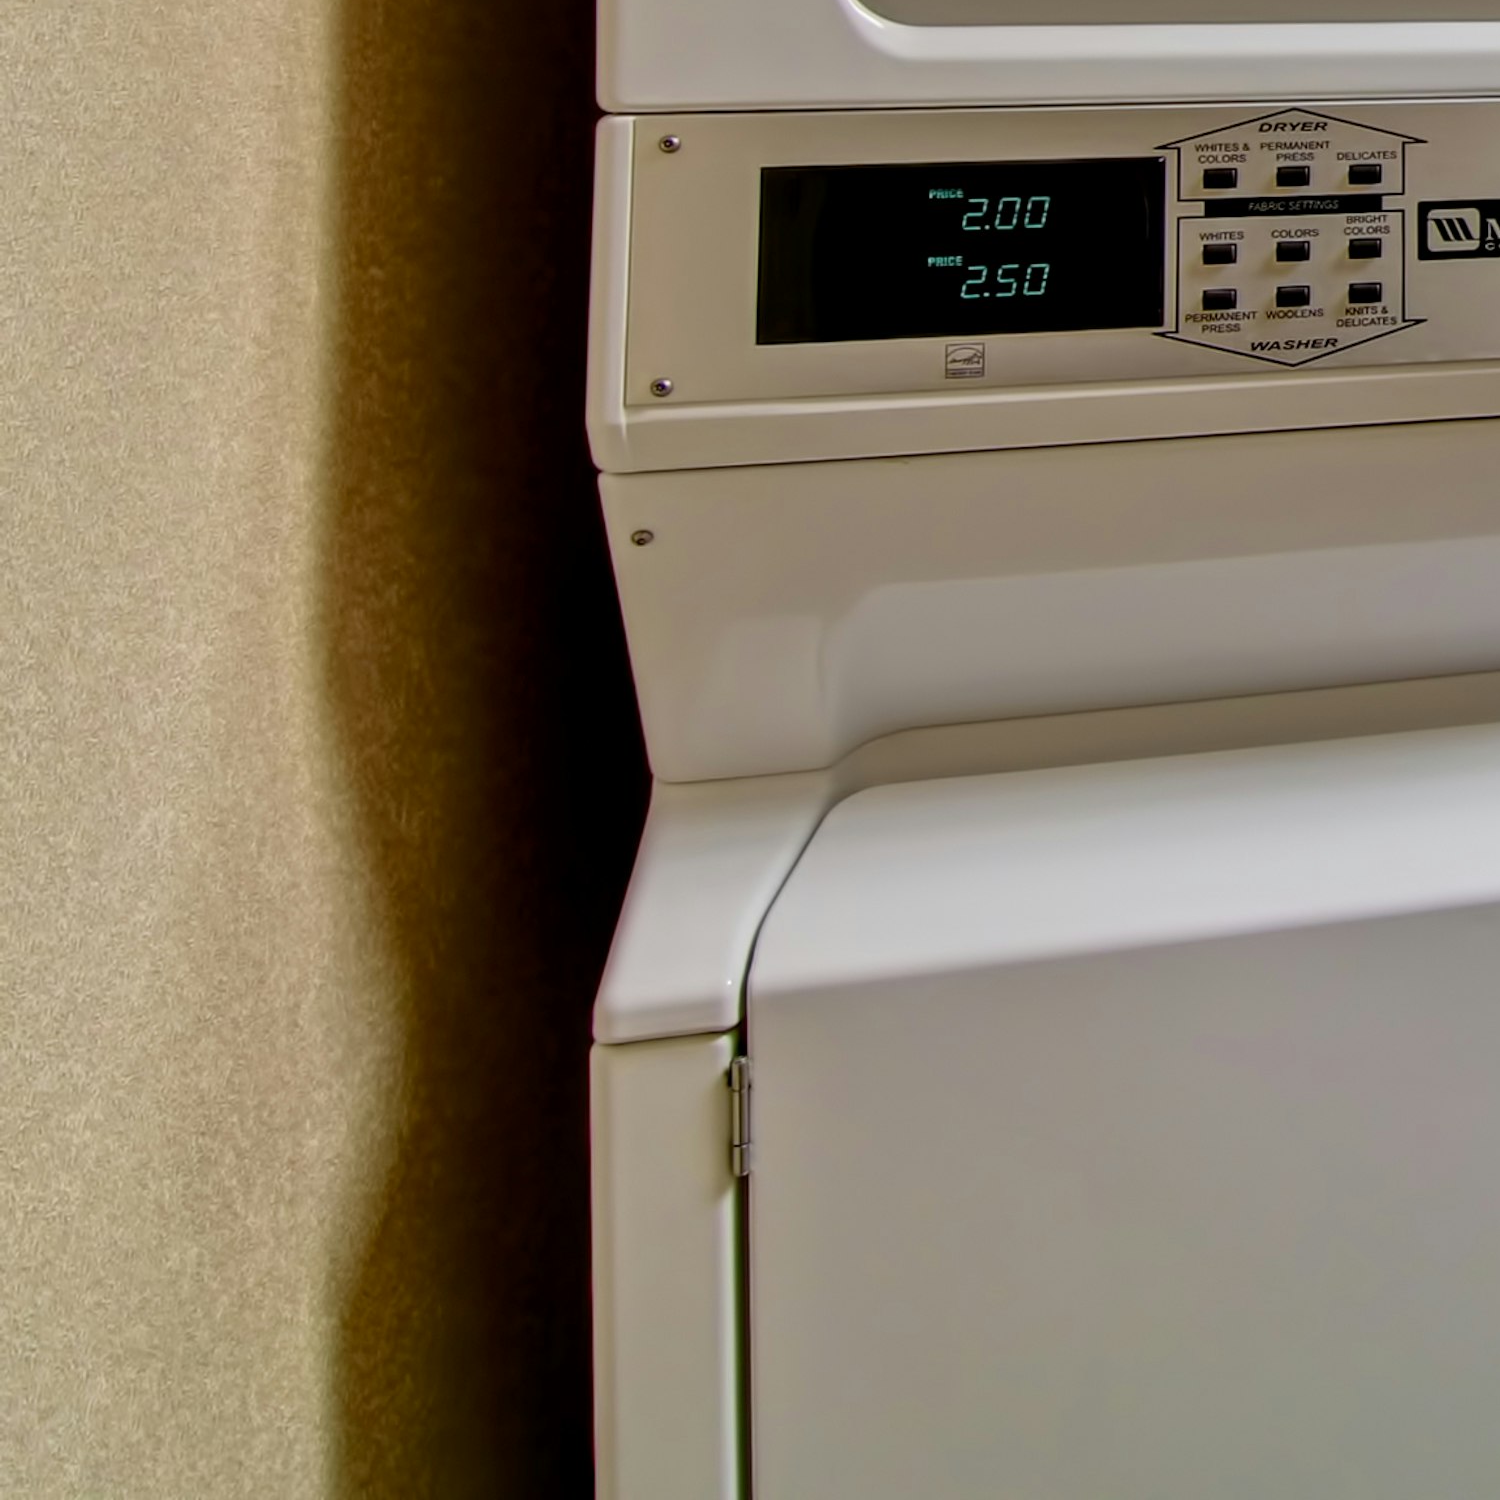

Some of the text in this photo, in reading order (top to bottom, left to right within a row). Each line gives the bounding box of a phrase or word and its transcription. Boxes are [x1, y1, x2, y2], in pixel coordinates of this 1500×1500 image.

[1258, 122, 1328, 133] DRYER
[1195, 142, 1250, 152] WHITES &
[1260, 140, 1330, 150] PERMANENT
[1198, 154, 1247, 164] COLORS
[1276, 152, 1315, 161] PRESS
[1337, 150, 1397, 161] DELICATES
[929, 189, 964, 199] PRICE
[1249, 200, 1339, 211] FABRIC SETTINGS
[962, 197, 1050, 230] 2.00
[1346, 215, 1387, 225] BRIGHT
[1271, 229, 1319, 238] COLORS
[1344, 225, 1390, 235] COLORS
[1200, 231, 1244, 241] WHITES
[928, 256, 963, 267] PRICE
[961, 264, 1049, 298] 2.50
[1267, 308, 1324, 319] WOOLENS
[1345, 306, 1378, 316] KNITS
[1185, 311, 1257, 323] PERMANENT
[1336, 316, 1397, 327] DELICATES
[1202, 323, 1241, 333] PRESS
[1251, 338, 1338, 351] WASHER
